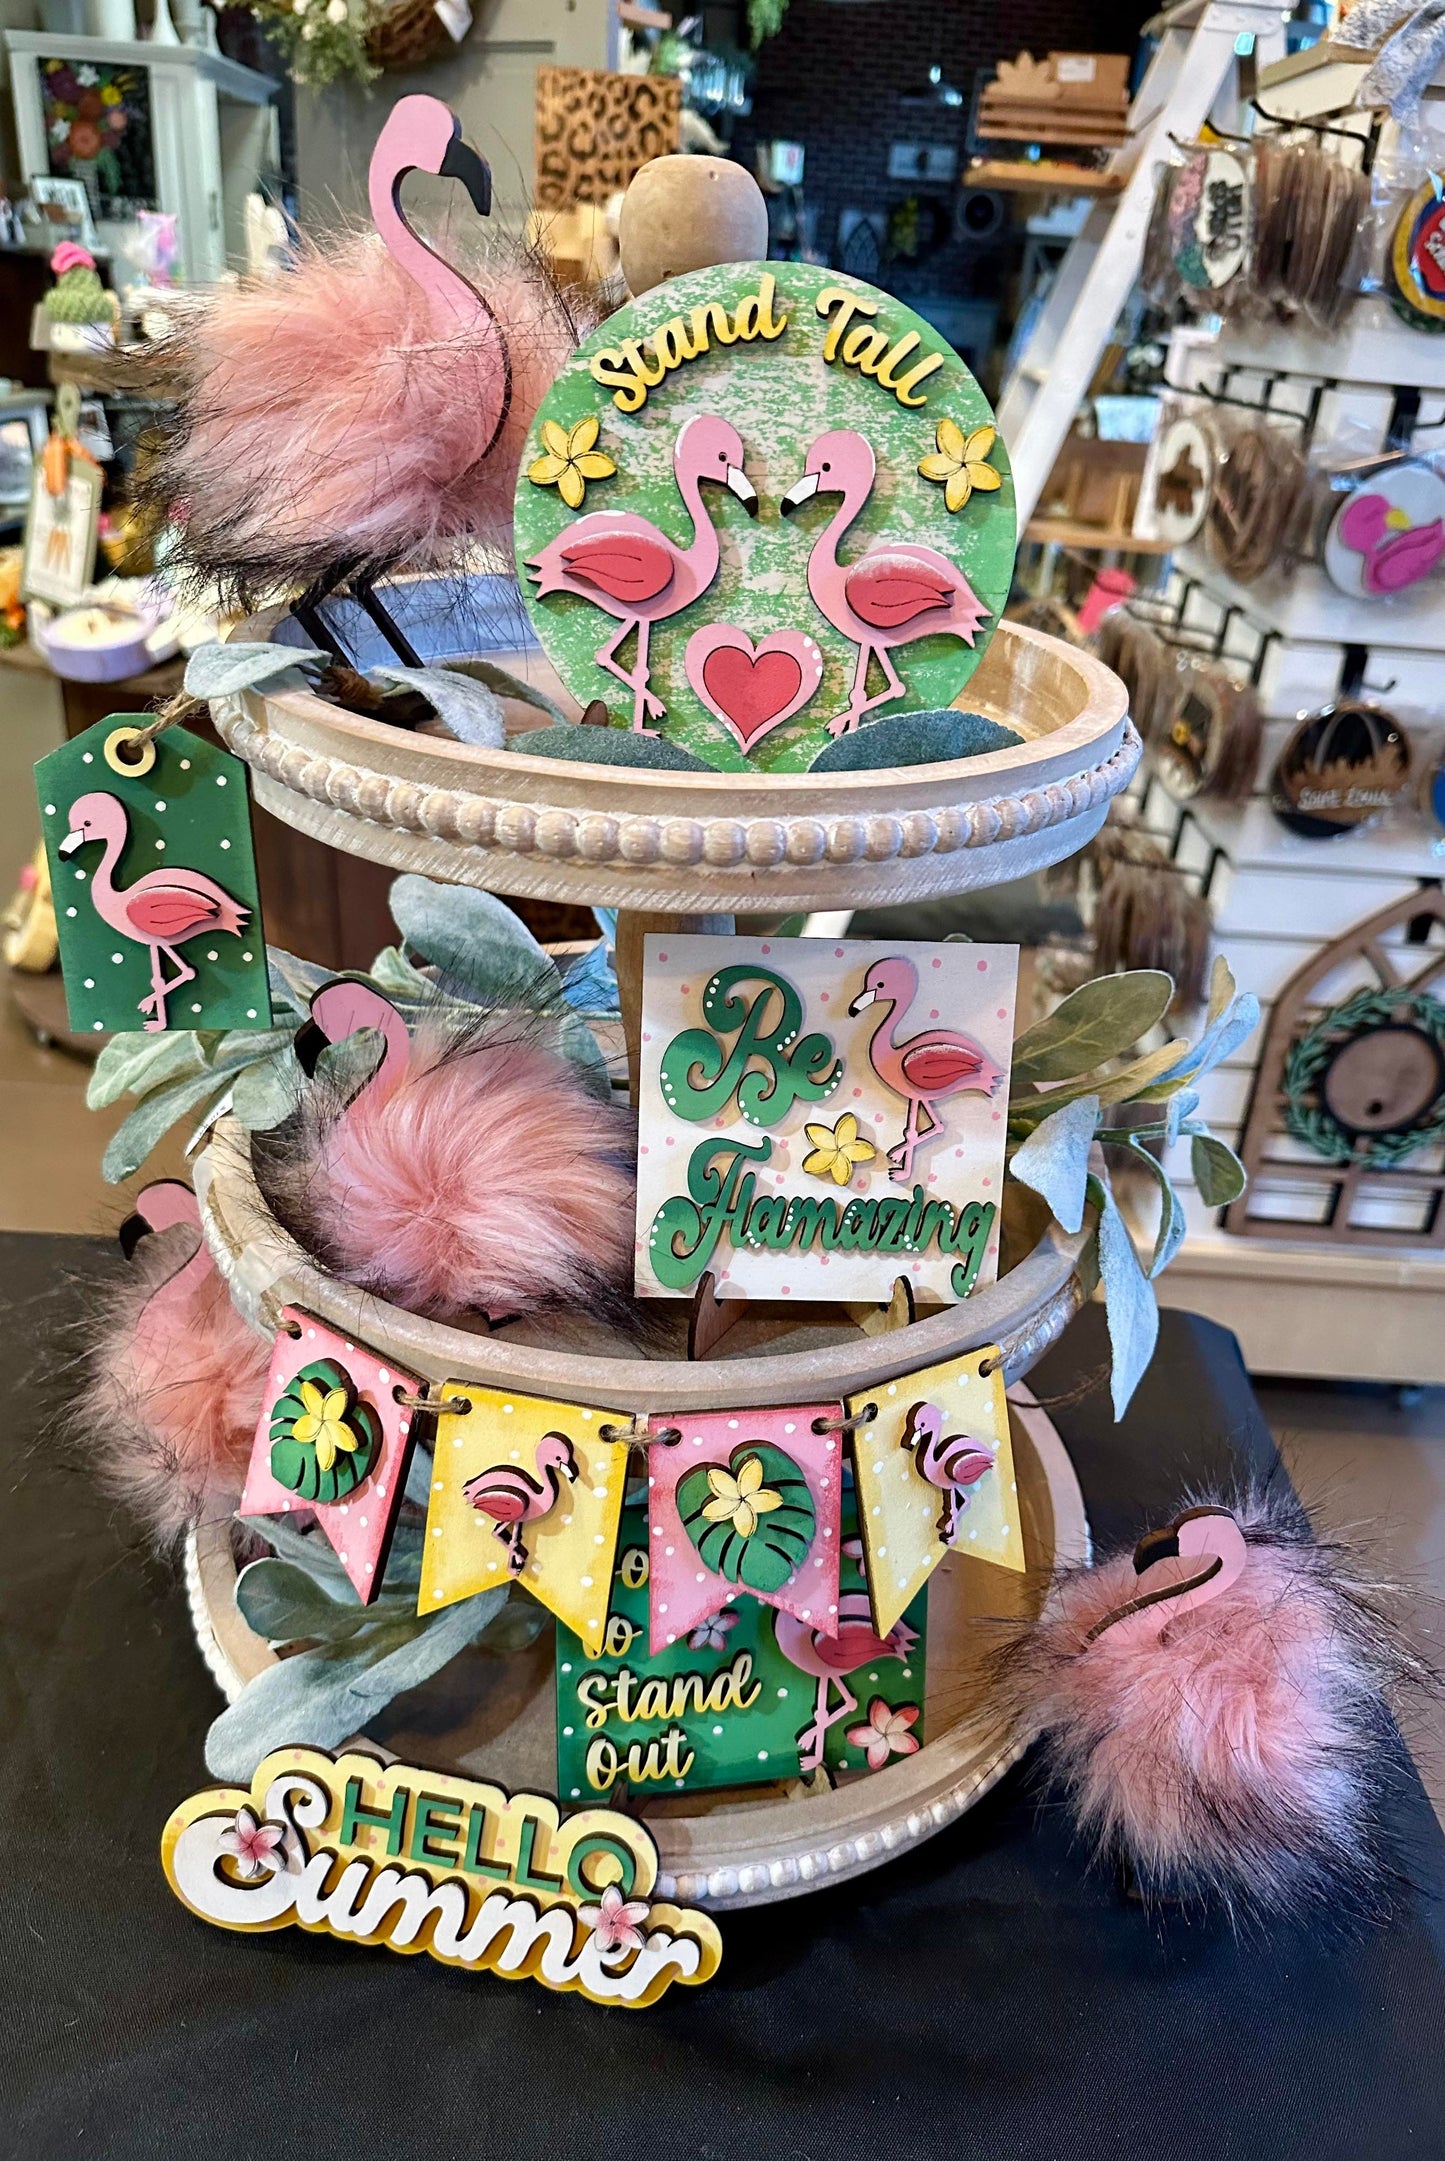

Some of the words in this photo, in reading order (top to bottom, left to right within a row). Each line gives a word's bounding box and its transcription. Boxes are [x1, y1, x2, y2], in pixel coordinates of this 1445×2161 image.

[590, 273, 788, 414] Stand
[815, 286, 945, 408] Tall
[660, 965, 843, 1127] Be
[577, 1654, 762, 1728] stand
[582, 1615, 643, 1660] o
[173, 1775, 700, 2000] Summer
[339, 1780, 636, 1900] HELLO
